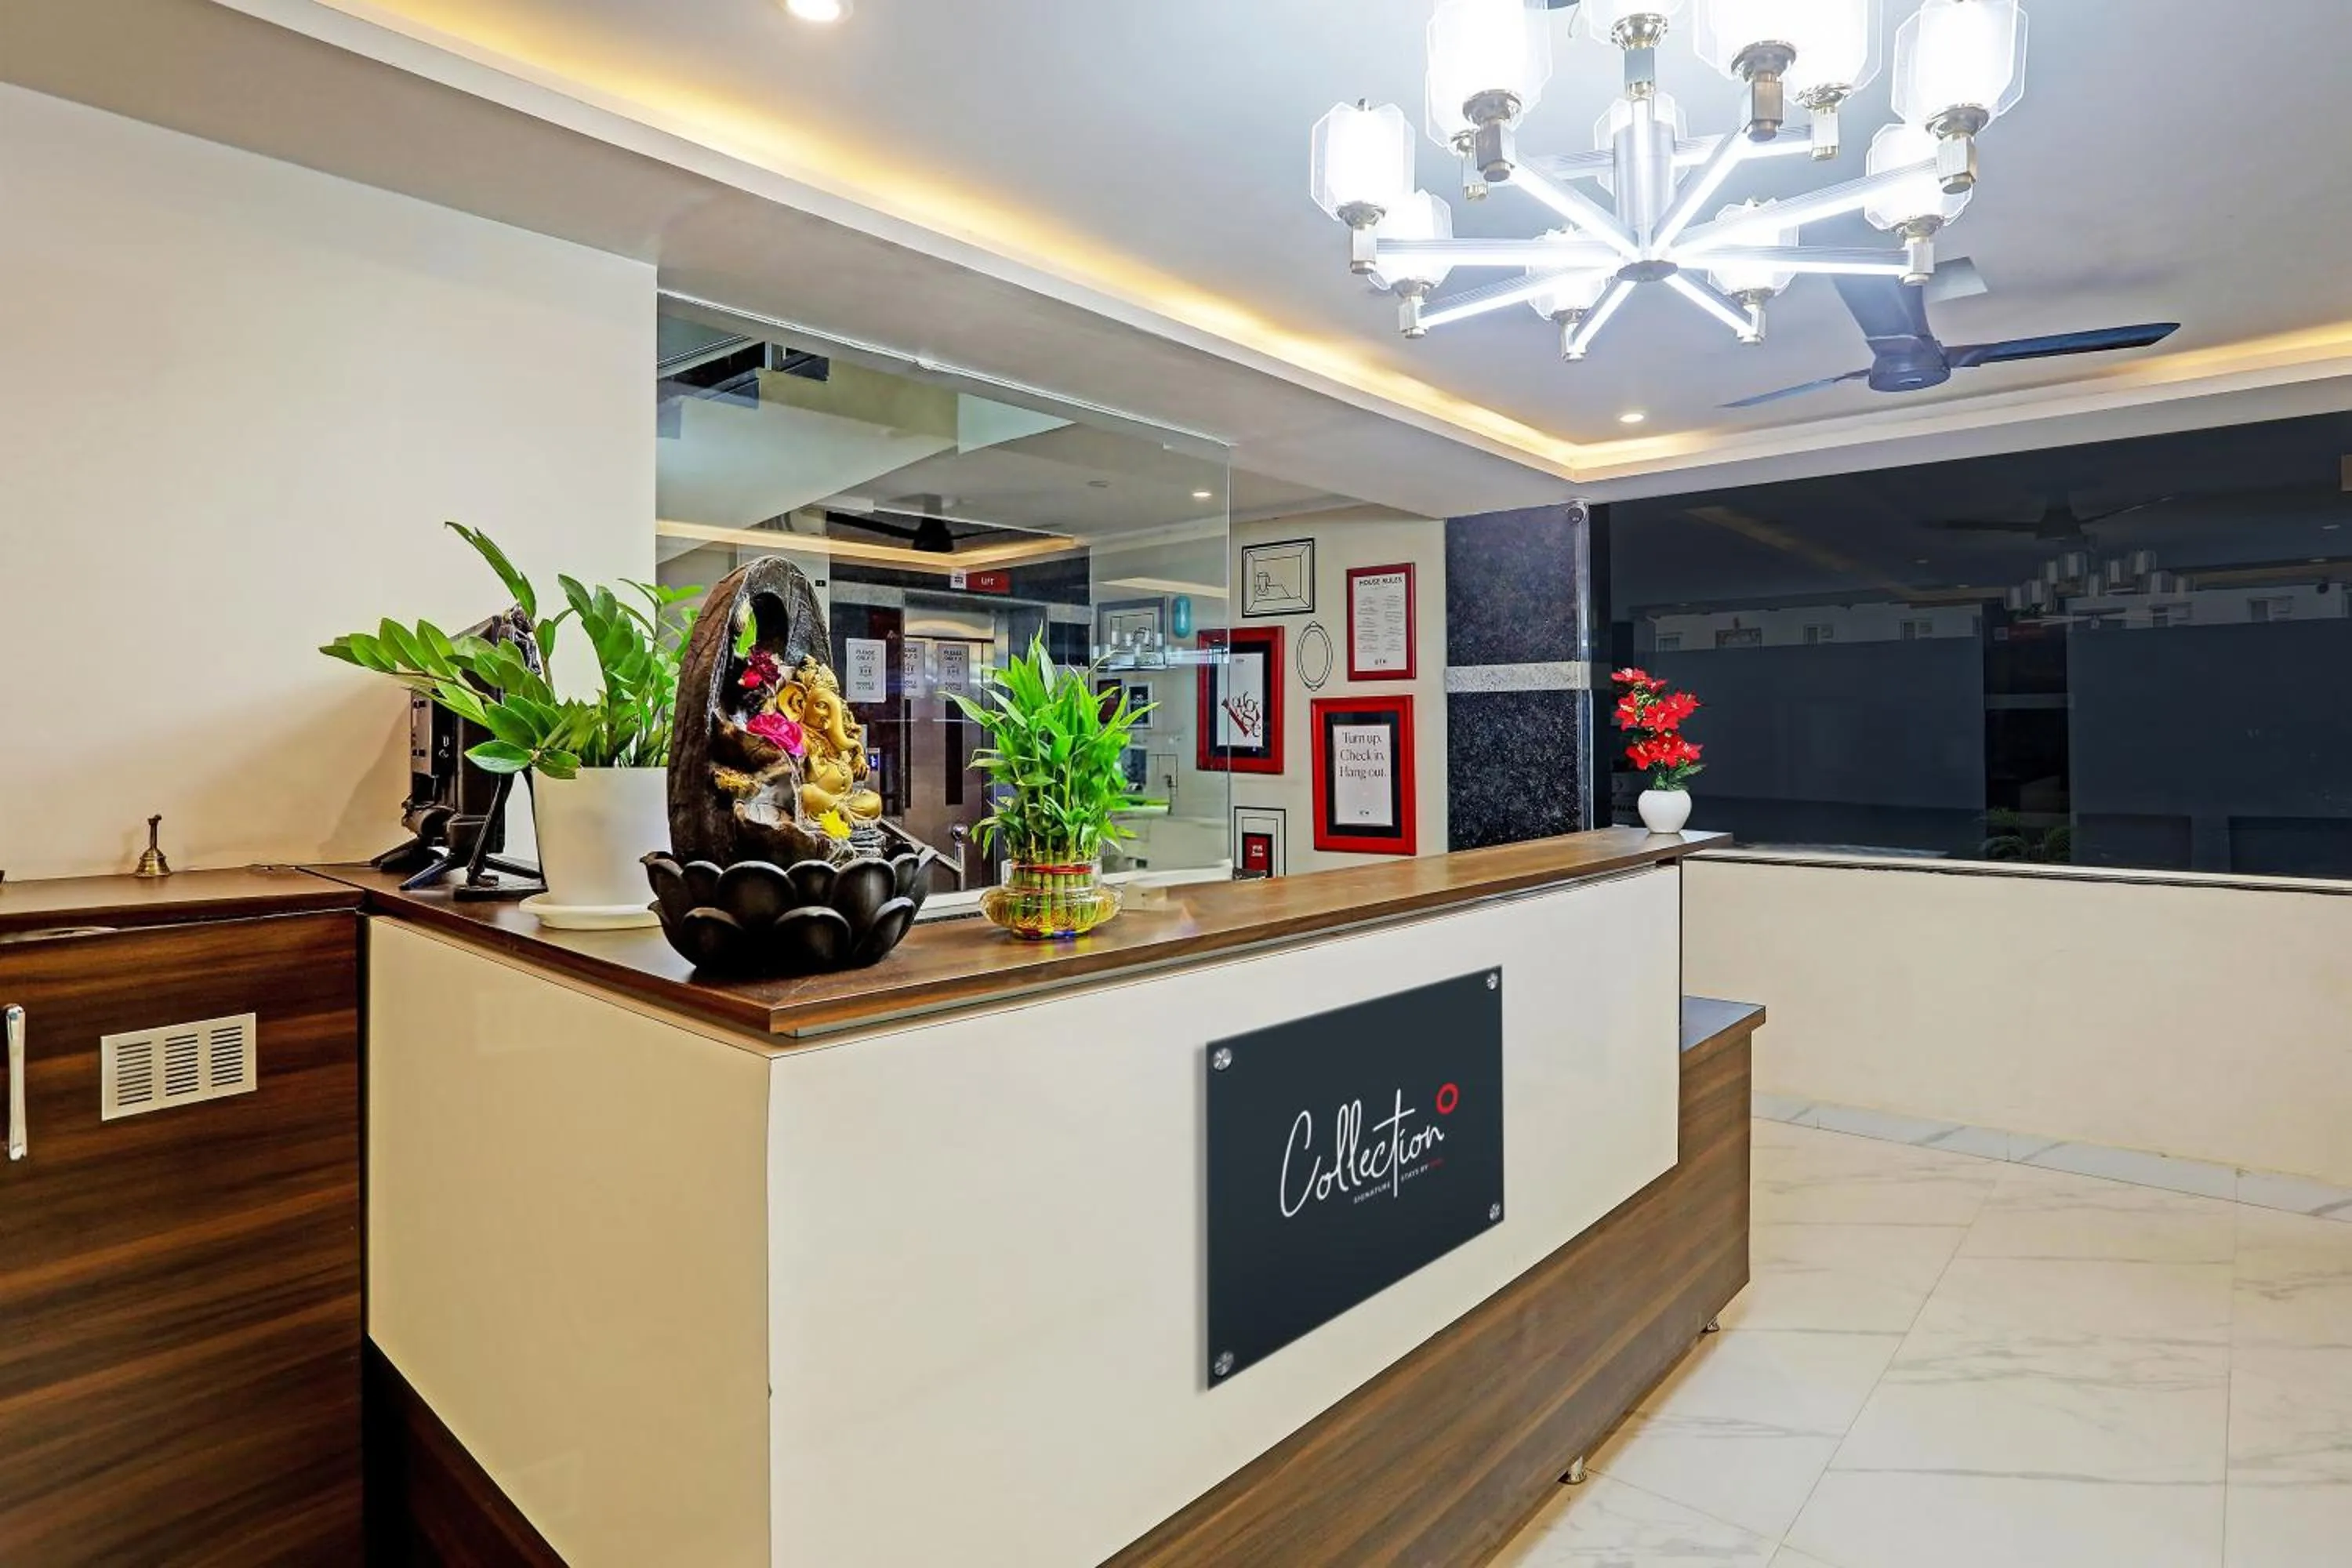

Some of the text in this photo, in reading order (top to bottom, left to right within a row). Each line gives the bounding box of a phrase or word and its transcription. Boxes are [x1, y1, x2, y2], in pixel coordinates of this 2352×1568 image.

[1342, 732, 1365, 744] Turn
[1340, 749, 1371, 761] Check
[1340, 766, 1367, 779] Hang
[1280, 1088, 1444, 1217] Collection
[1354, 1181, 1391, 1204] SIGNATURE
